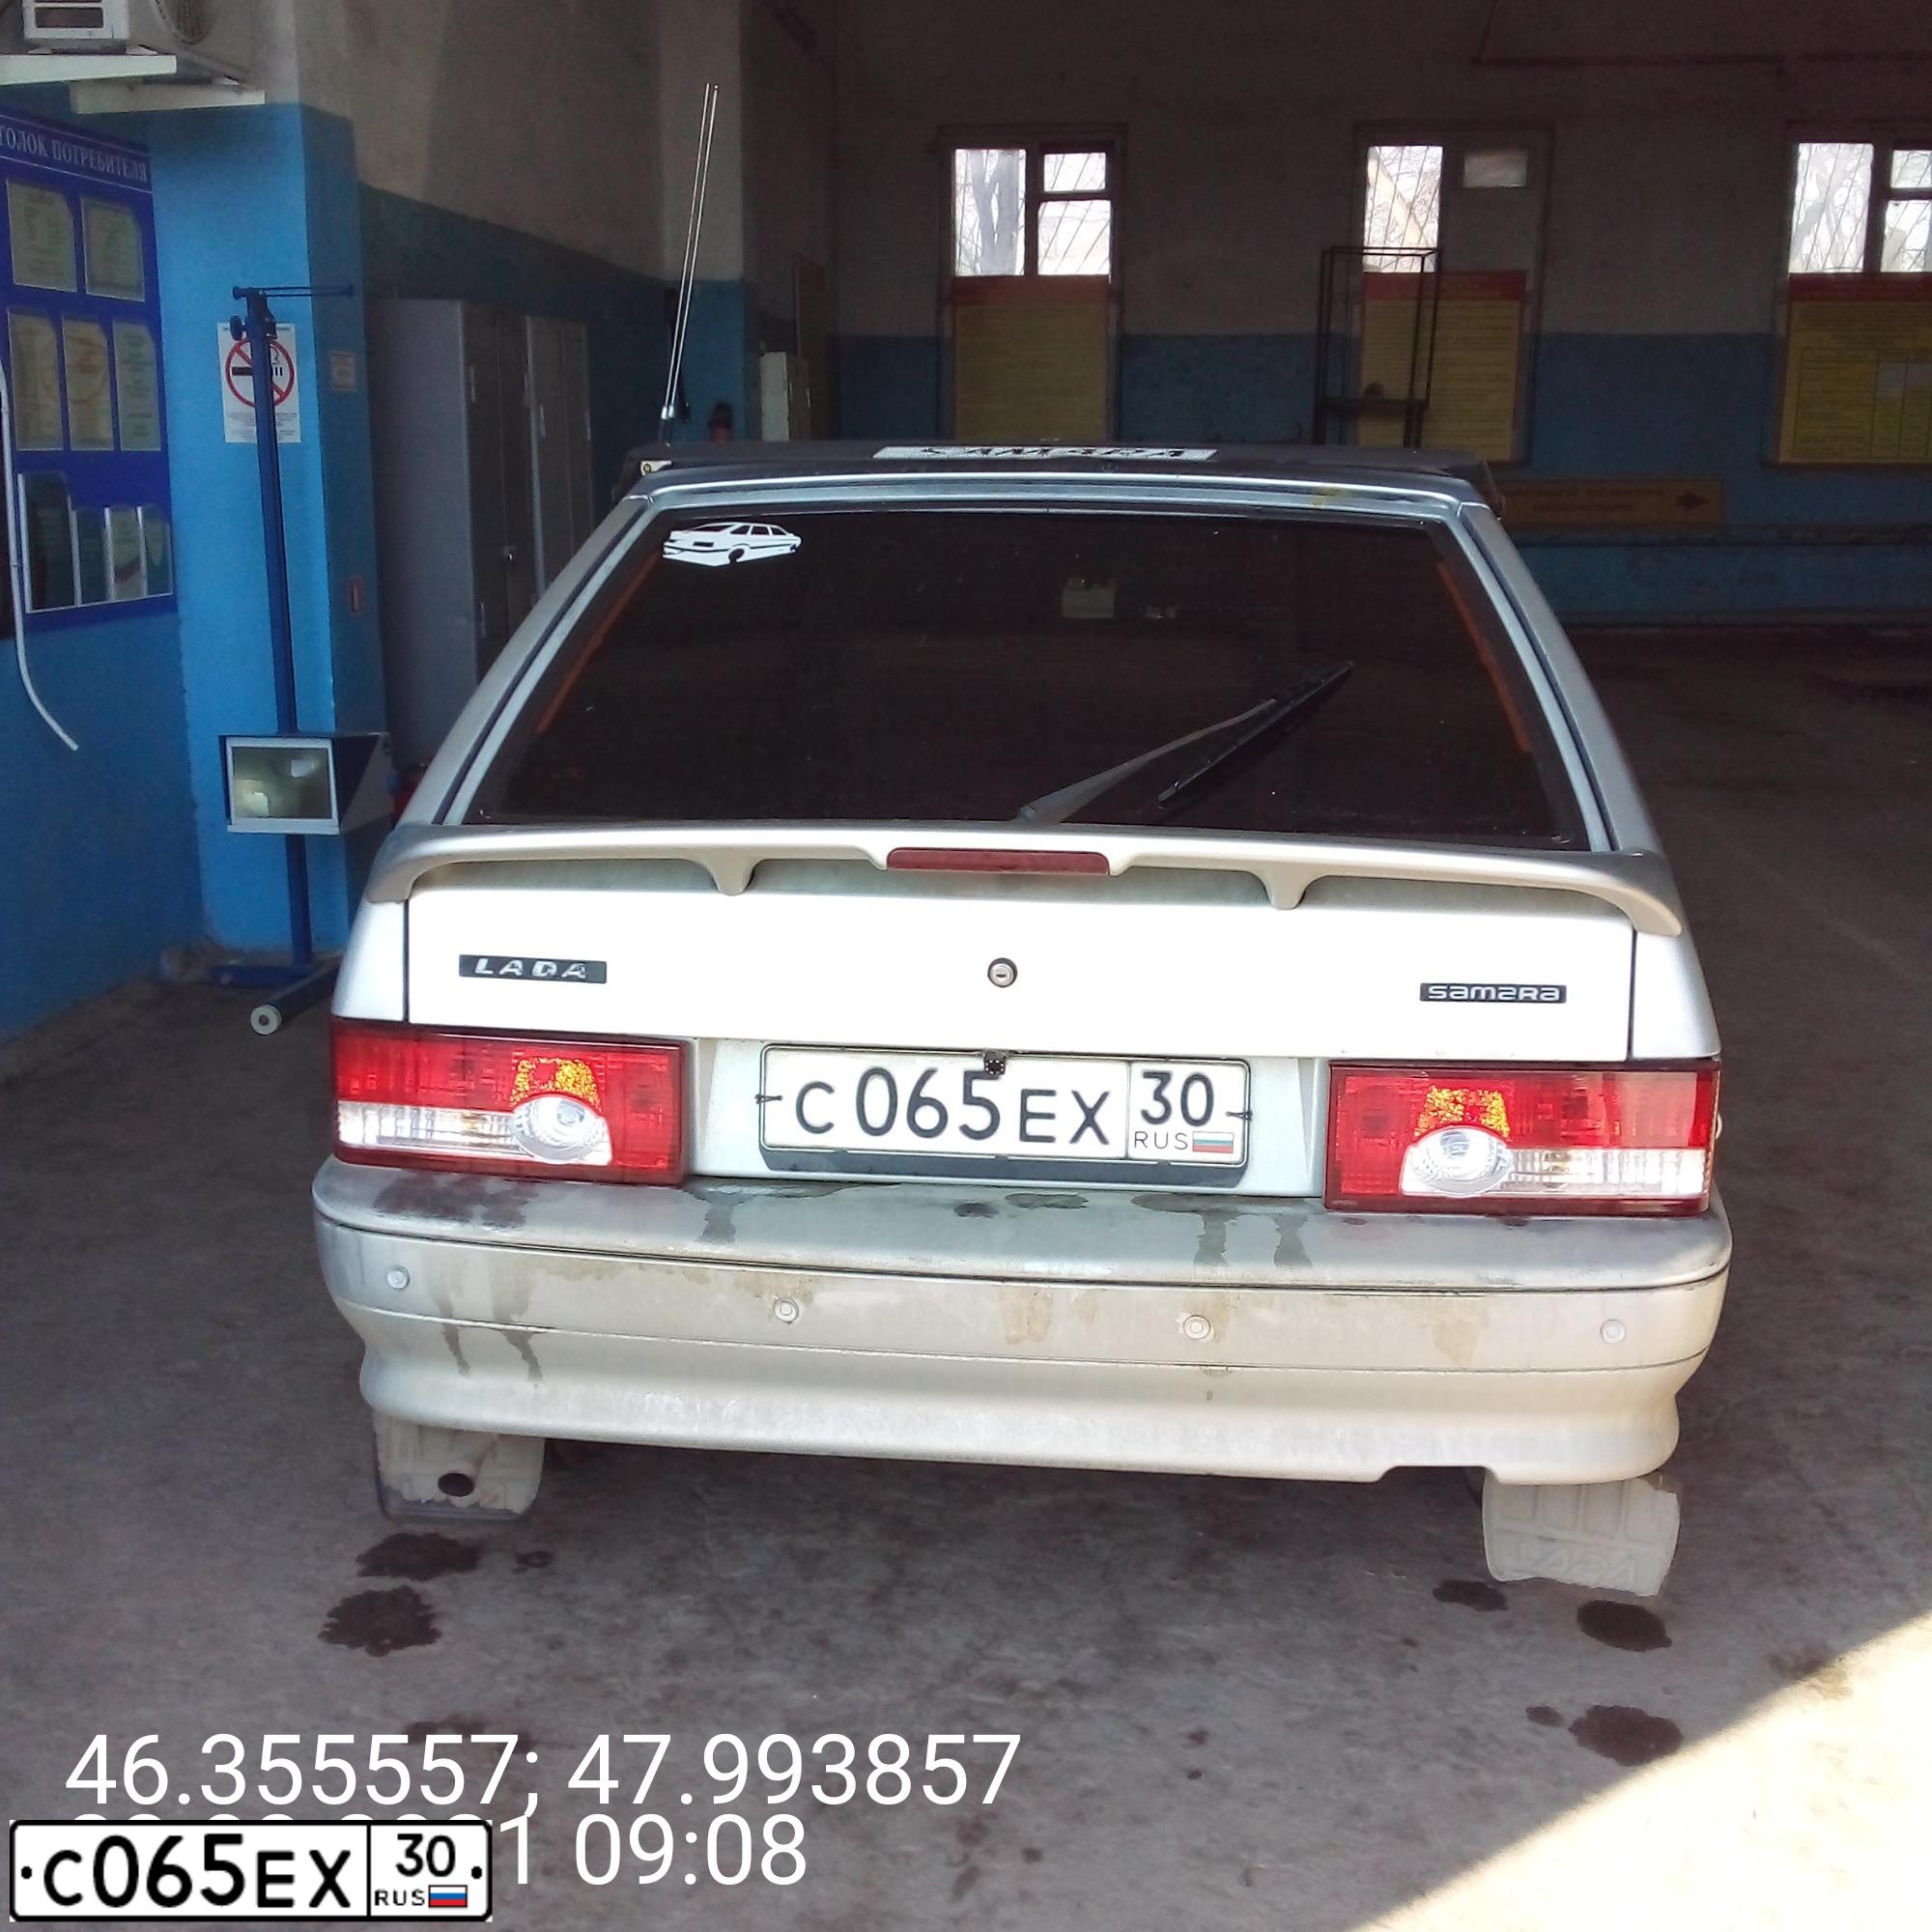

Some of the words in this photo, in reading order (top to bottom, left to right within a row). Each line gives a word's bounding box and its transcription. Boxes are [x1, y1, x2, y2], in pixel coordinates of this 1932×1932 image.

[51, 139, 147, 183] ПОТРЕБИТЕЛЯ
[473, 957, 587, 980] LADA
[1141, 1071, 1214, 1126] 30
[1134, 1131, 1188, 1151] RUS
